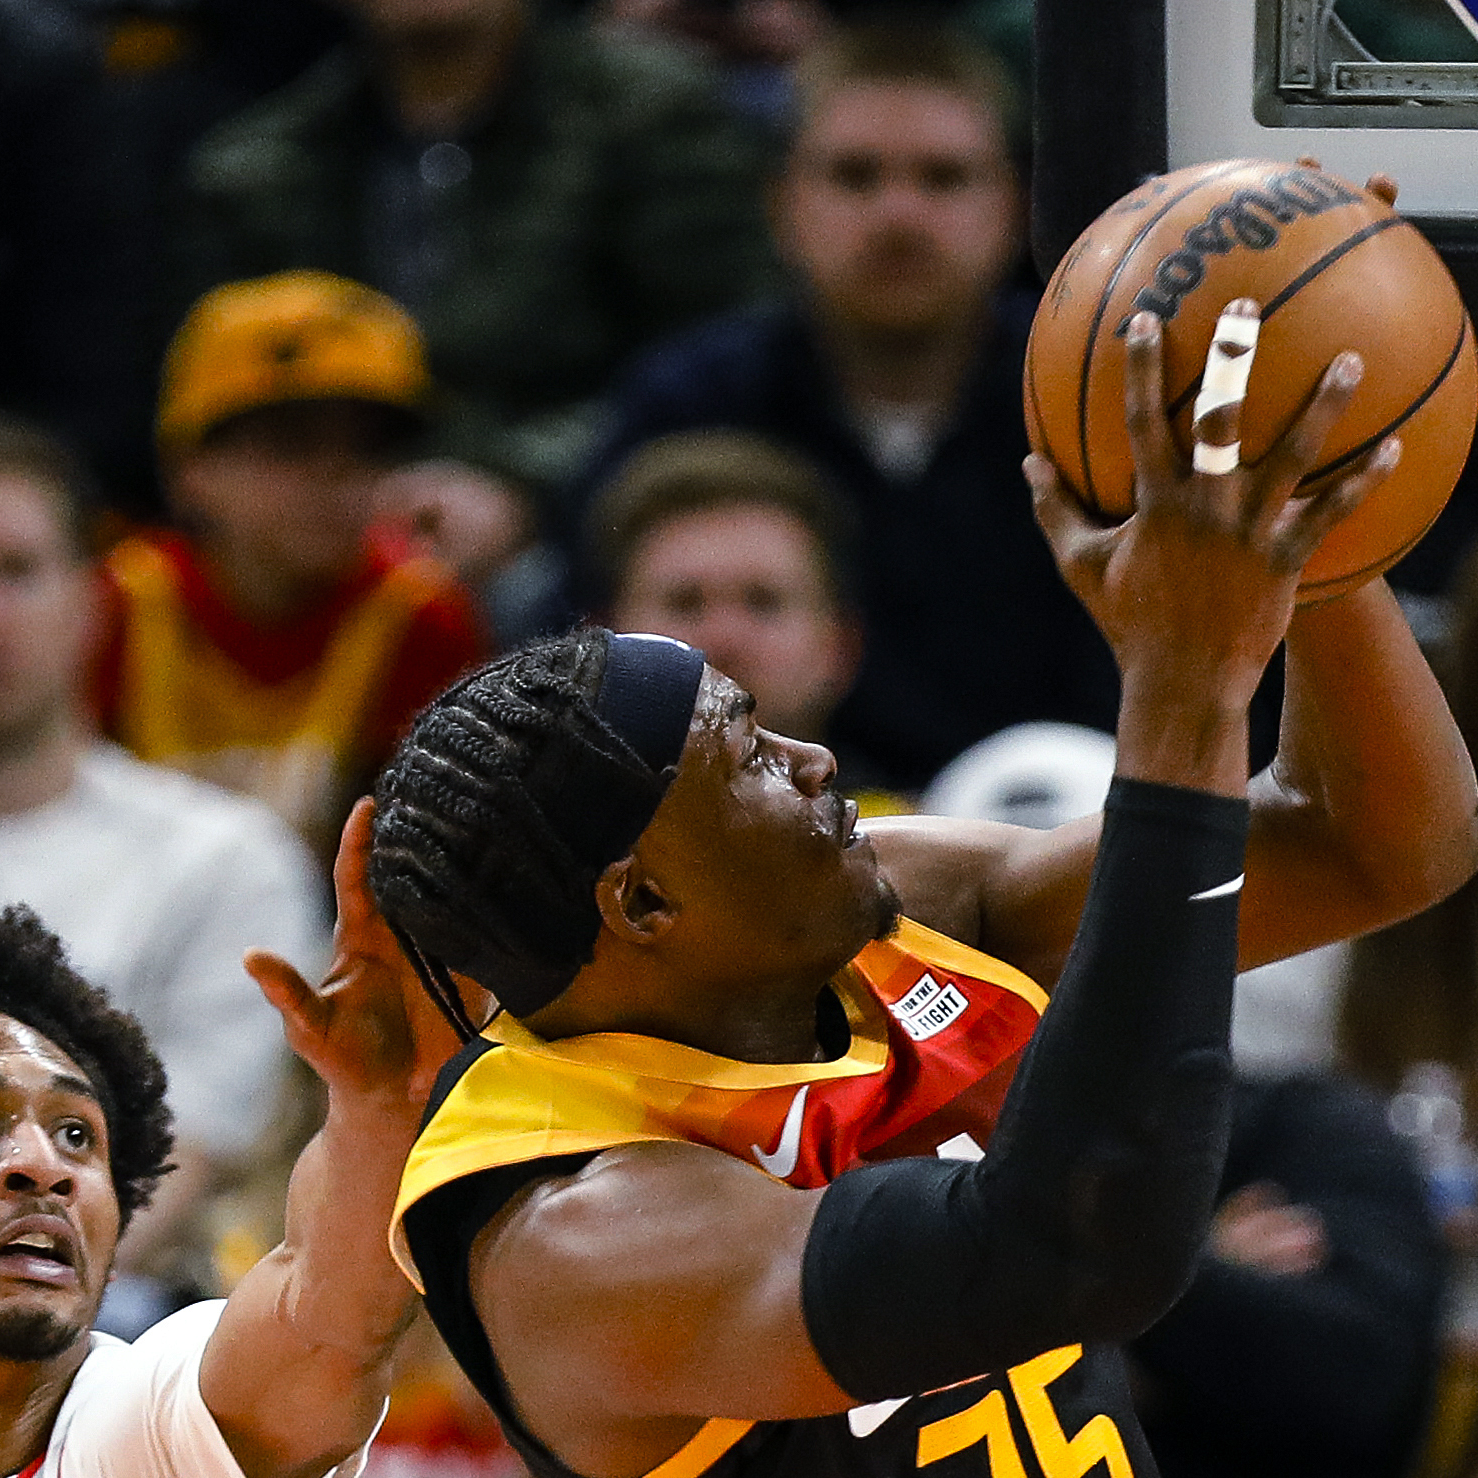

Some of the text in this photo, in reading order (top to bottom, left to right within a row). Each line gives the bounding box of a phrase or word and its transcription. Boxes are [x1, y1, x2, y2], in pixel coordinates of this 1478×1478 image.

[901, 981, 934, 1012] FOR THE
[918, 991, 959, 1031] FIGHT
